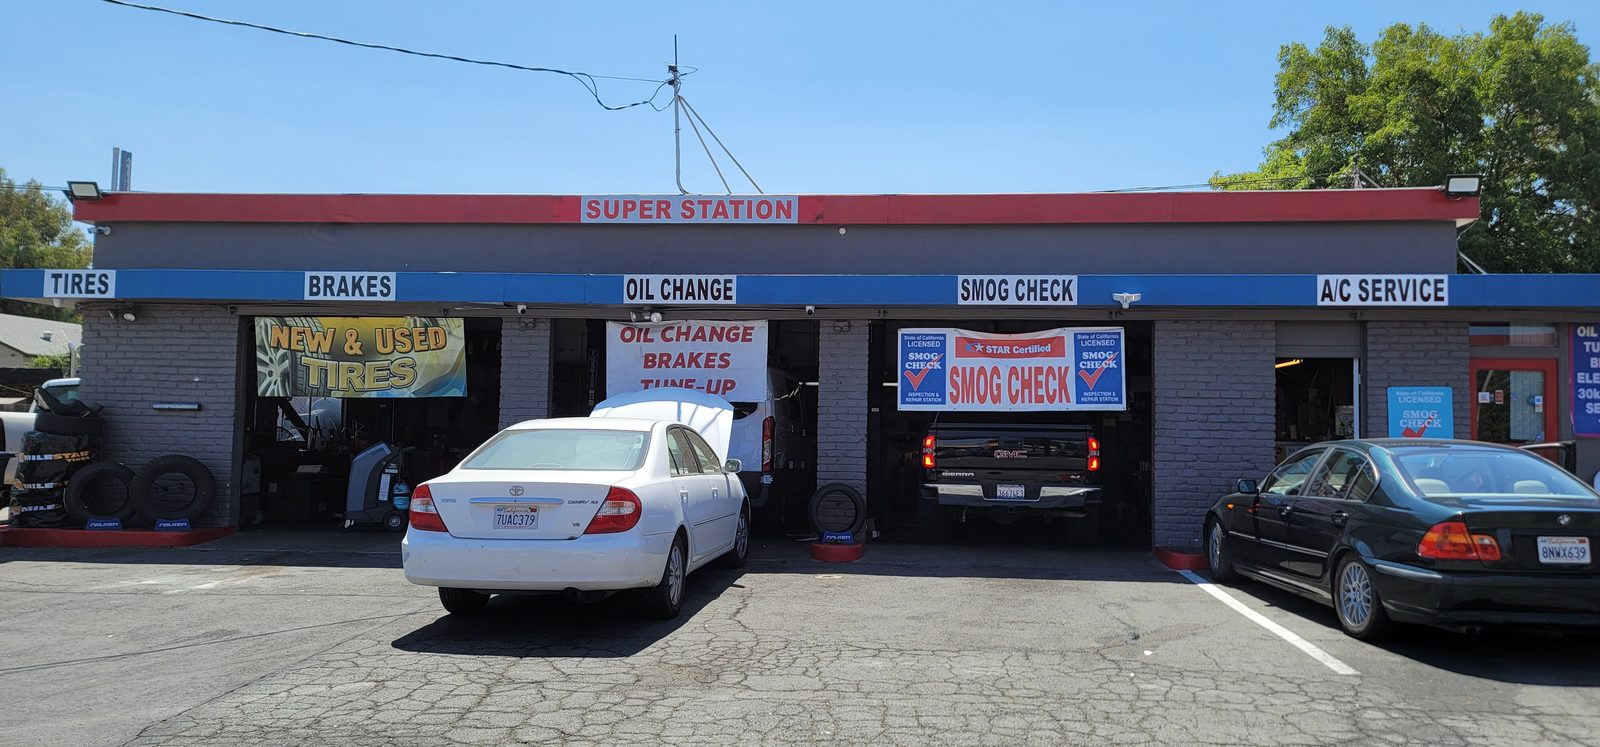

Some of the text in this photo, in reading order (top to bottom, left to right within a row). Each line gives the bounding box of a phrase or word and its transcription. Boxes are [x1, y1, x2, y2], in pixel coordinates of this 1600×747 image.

[586, 199, 792, 219] SUPER STATION
[51, 273, 109, 295] TIRES
[309, 275, 391, 297] BRAKES
[626, 278, 733, 300] OIL CHANGE
[961, 278, 1073, 301] SMOG CHECK
[1320, 278, 1445, 302] A/C SERVICE
[619, 325, 755, 343] OIL CHANGE
[1577, 326, 1598, 337] OIL
[270, 325, 448, 356] NEW & USED
[1081, 339, 1115, 347] LICENSED
[986, 343, 1051, 354] STAR Certified
[643, 352, 731, 369] BRAKES
[908, 352, 939, 360] SMOG
[1082, 351, 1114, 360] SMOG
[905, 361, 942, 370] CHECK
[1079, 360, 1118, 369] CHECK
[1590, 357, 1600, 368] B
[301, 356, 418, 392] TIRES
[949, 365, 1071, 405] SMOG CHECK
[1402, 410, 1439, 419] SMOG
[1400, 419, 1442, 428] CHECK
[993, 449, 1028, 459] GMC
[503, 506, 529, 514] California
[497, 514, 536, 526] 7UAC379
[1541, 546, 1586, 559] 8NWX639
